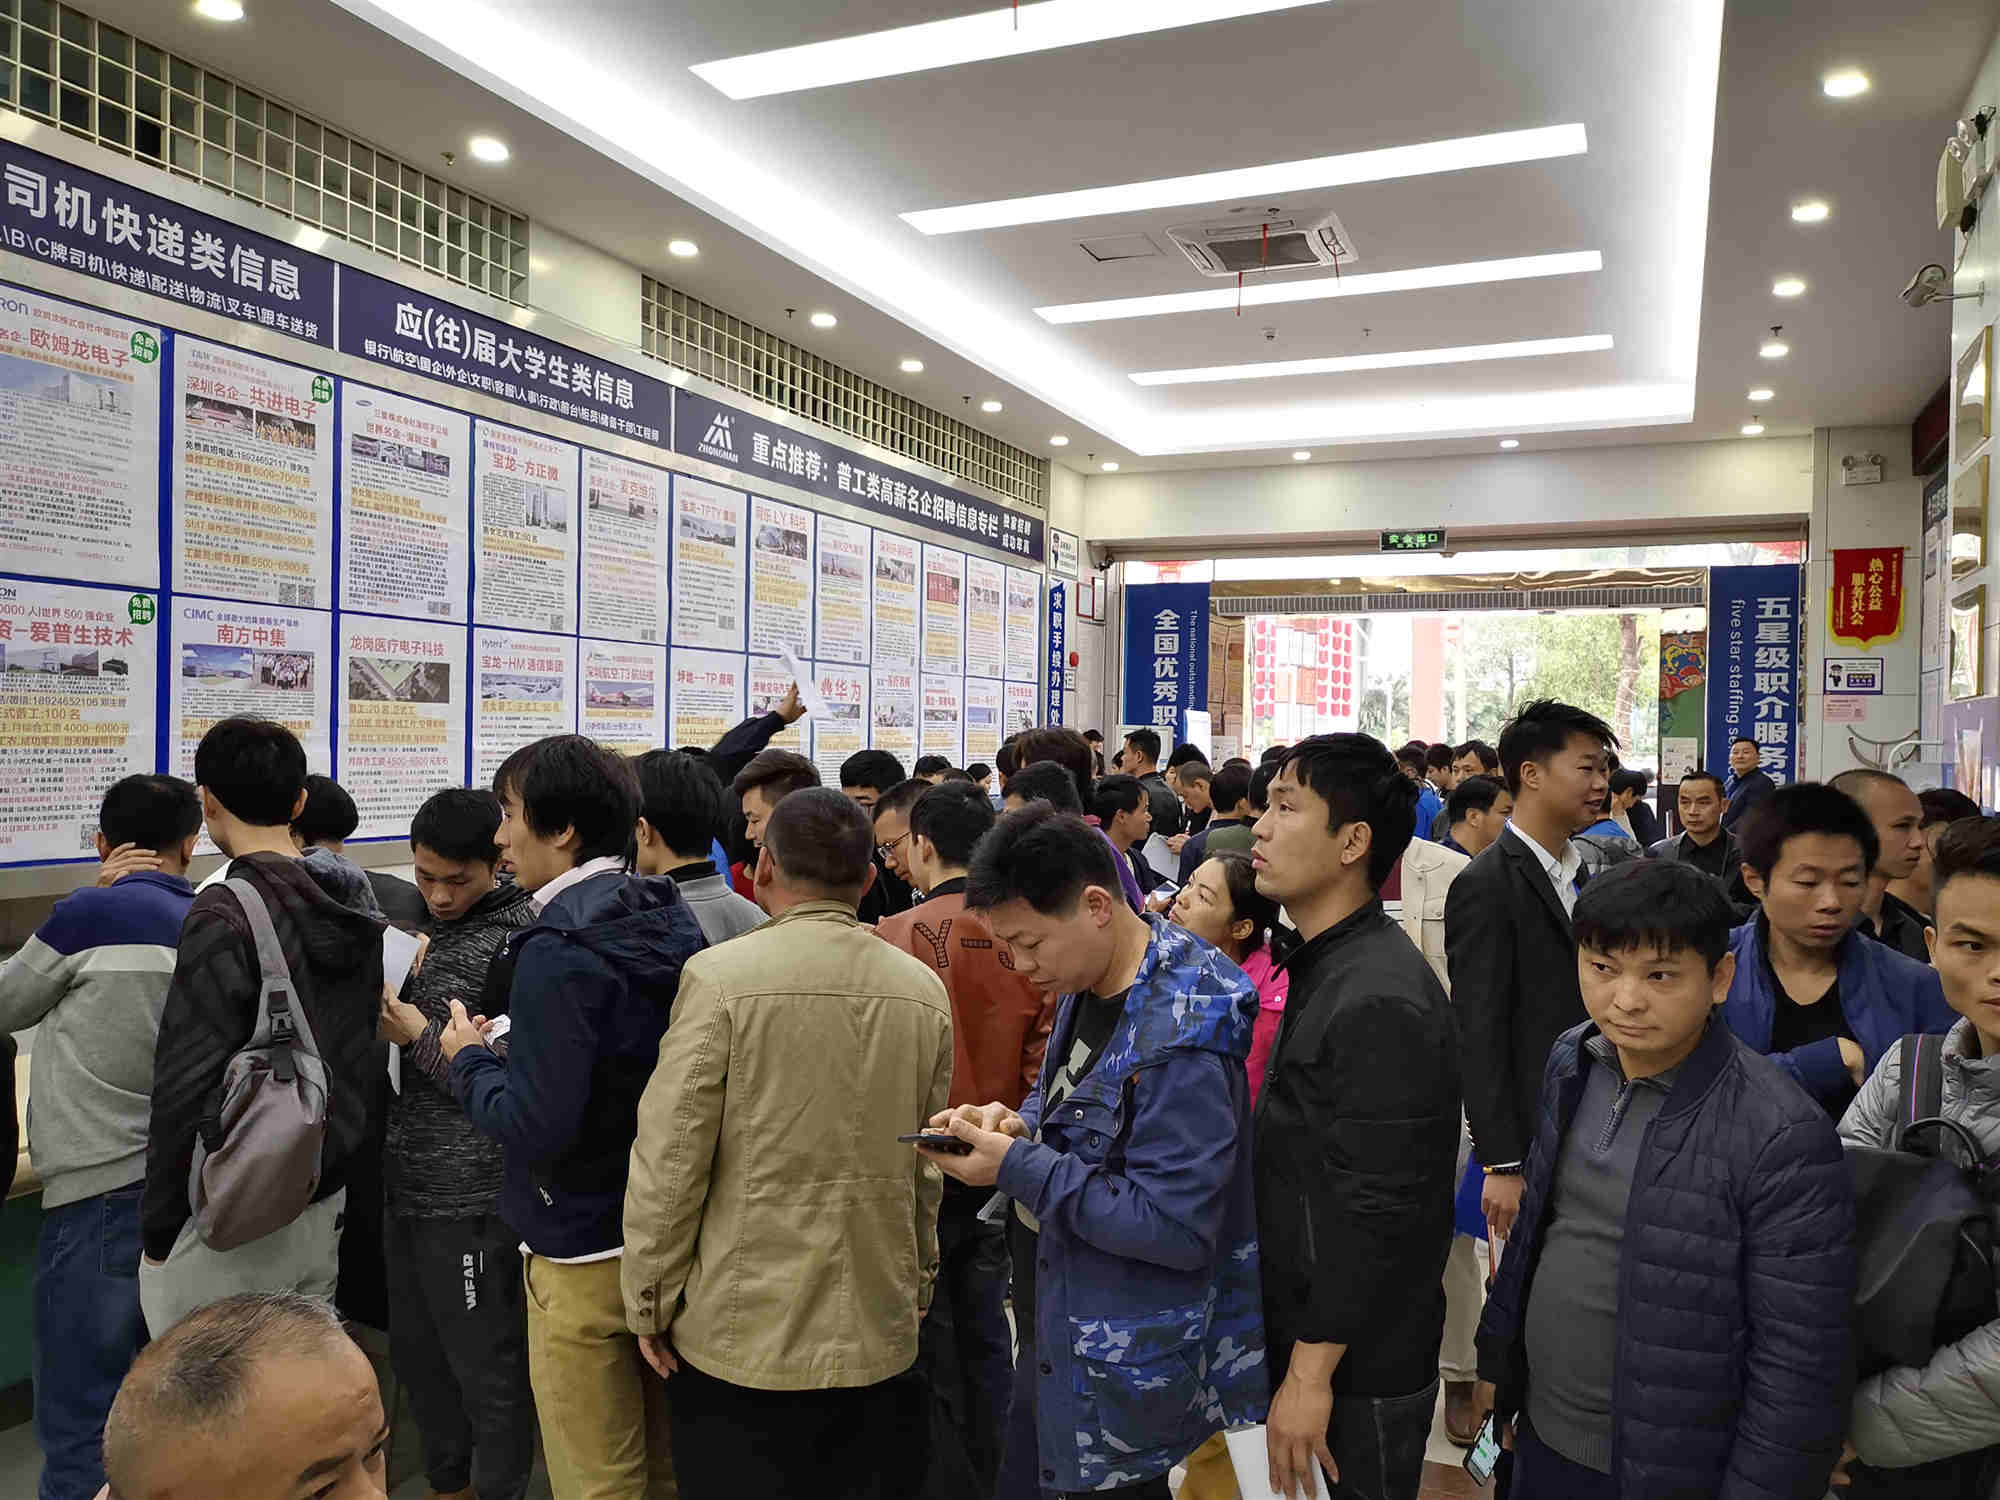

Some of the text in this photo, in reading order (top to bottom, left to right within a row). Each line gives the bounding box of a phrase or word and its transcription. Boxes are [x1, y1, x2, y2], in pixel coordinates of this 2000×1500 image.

[4, 163, 301, 301] 司机快递类信息
[1732, 600, 1746, 628] five
[216, 624, 286, 647] 南方中集
[1730, 631, 1741, 661] star
[1152, 608, 1181, 728] 全国优秀职
